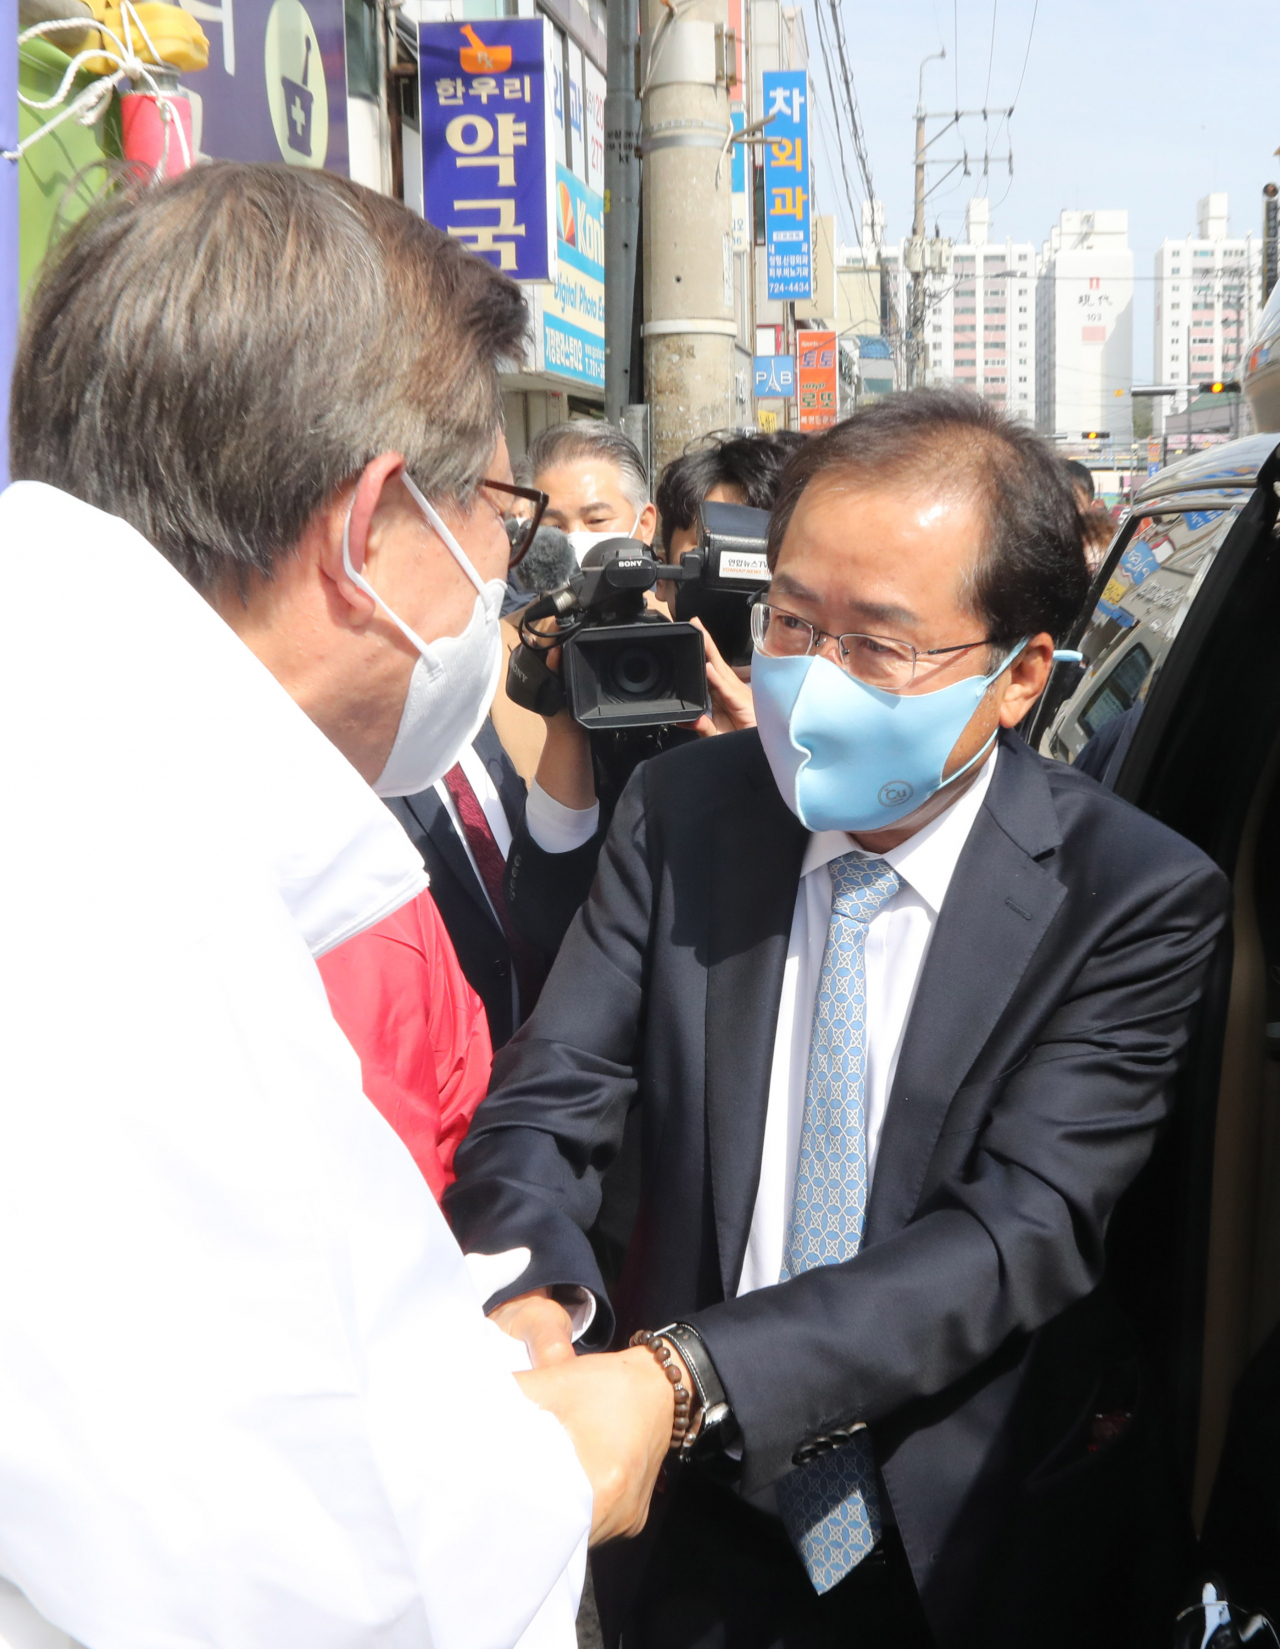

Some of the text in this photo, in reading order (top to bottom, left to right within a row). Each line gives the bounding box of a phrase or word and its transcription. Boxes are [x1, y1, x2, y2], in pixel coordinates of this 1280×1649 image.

[436, 76, 531, 105] 한우리
[445, 112, 527, 270] 약국
[554, 272, 577, 314] Digital
[579, 284, 597, 319] Photo
[769, 282, 809, 293] 724-4434
[1087, 313, 1102, 322] 103
[801, 351, 835, 368] 토토
[801, 392, 835, 408] 로또
